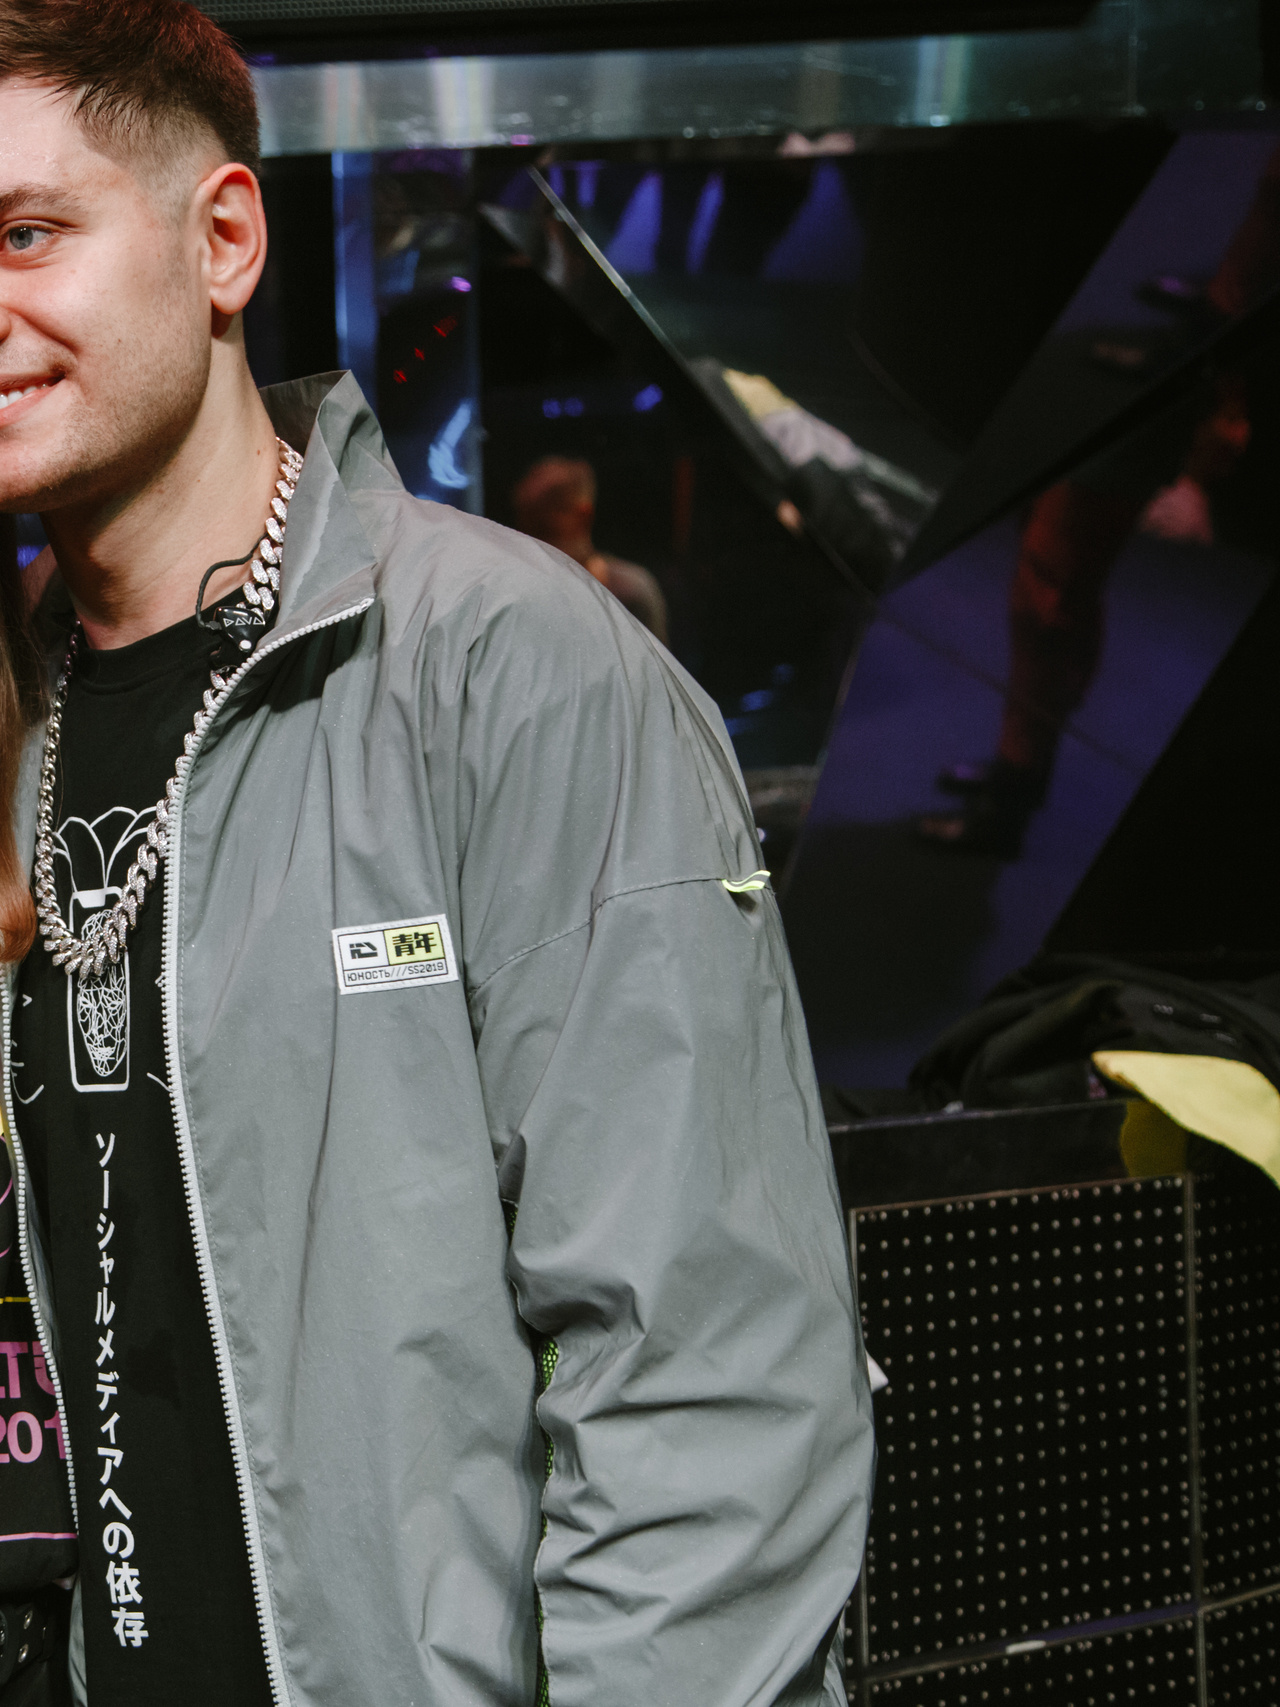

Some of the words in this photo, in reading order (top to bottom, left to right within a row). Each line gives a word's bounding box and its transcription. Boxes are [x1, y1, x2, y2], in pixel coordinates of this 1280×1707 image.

[392, 931, 437, 957] 青年
[95, 1132, 150, 1648] ソーシャルメディアへの依存
